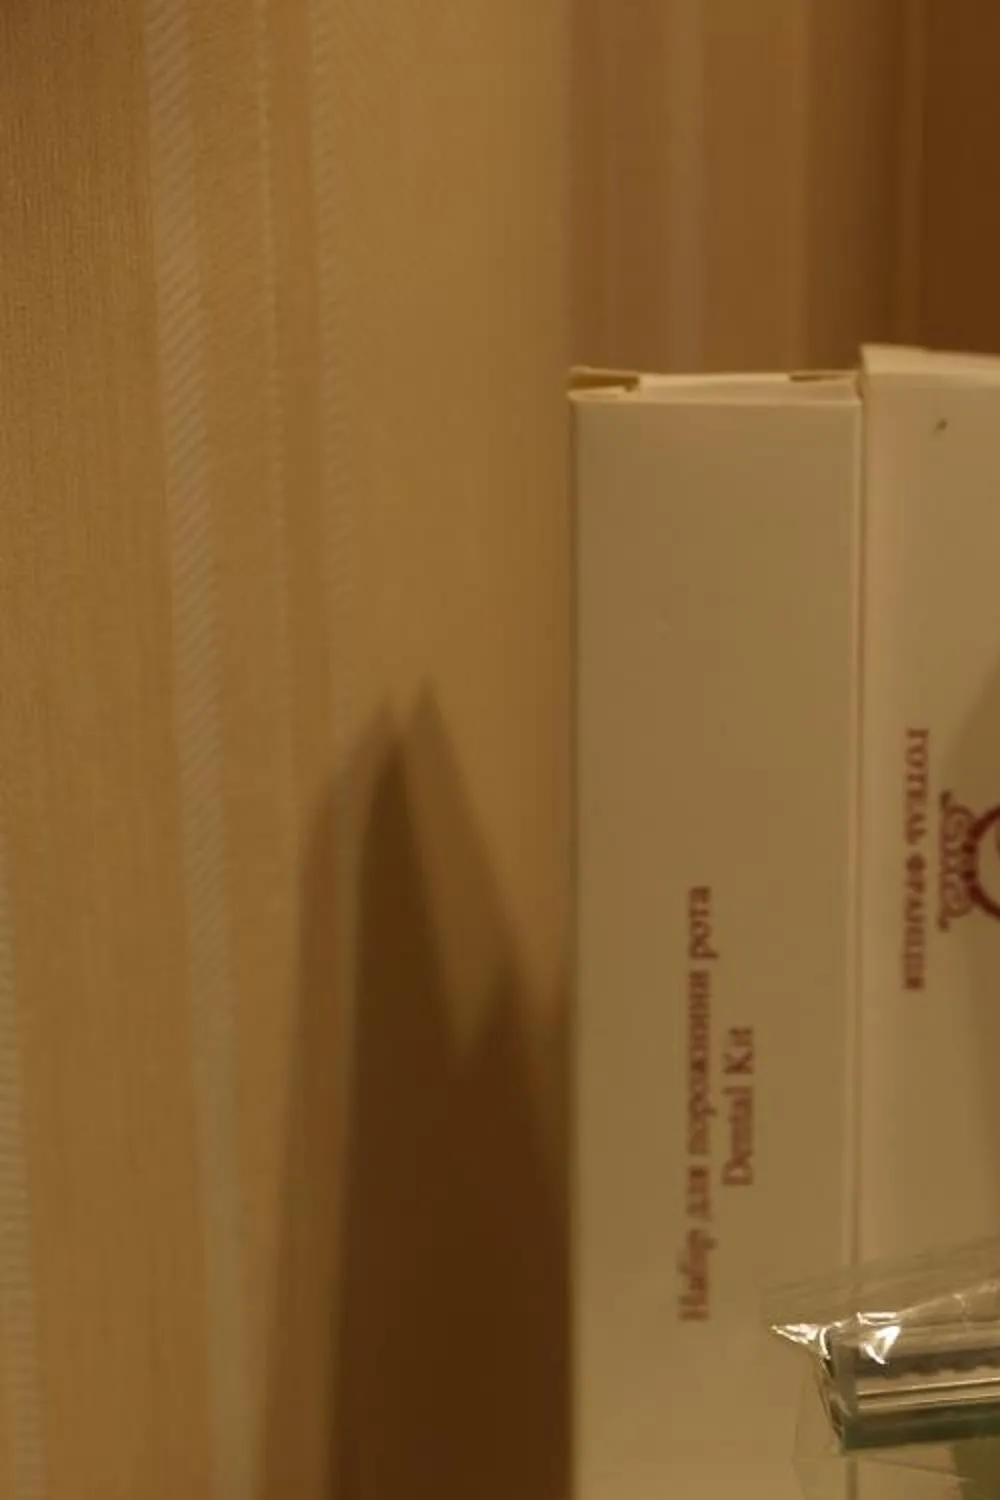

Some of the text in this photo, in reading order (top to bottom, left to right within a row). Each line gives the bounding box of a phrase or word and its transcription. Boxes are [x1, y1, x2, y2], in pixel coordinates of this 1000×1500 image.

[904, 728, 930, 847] ГОТЕЛЬ
[688, 885, 716, 961] рота
[721, 1027, 755, 1187] Dental Kit
[686, 1165, 711, 1221] для
